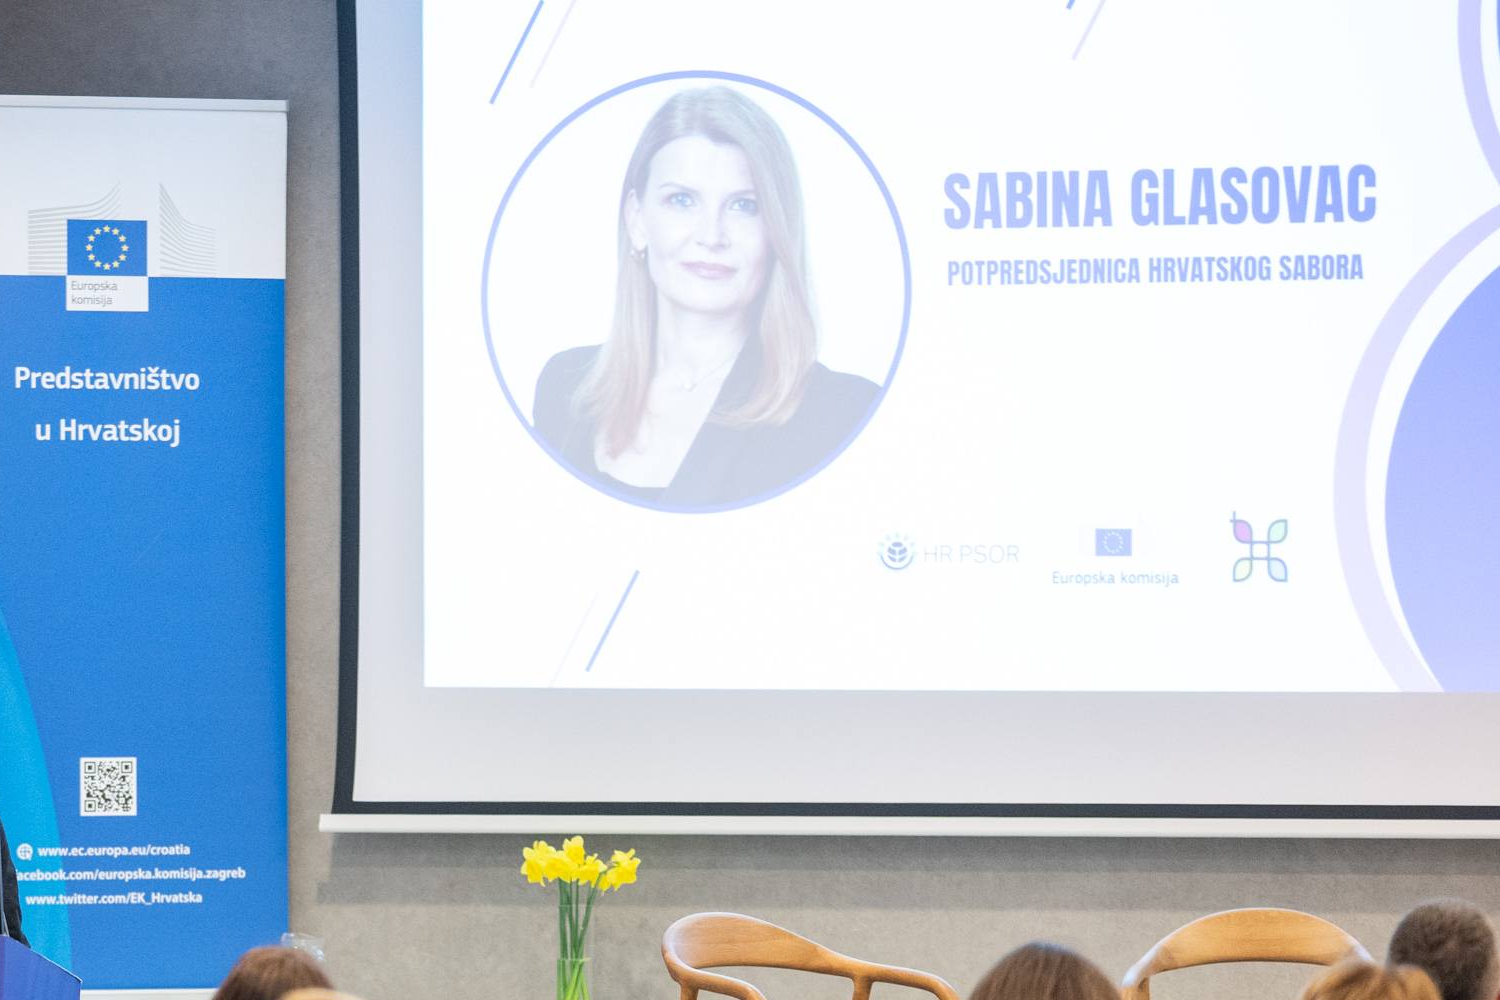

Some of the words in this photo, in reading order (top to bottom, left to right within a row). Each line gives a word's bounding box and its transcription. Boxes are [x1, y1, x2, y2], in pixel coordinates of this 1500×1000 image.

[943, 169, 1113, 230] SABINA
[1130, 163, 1377, 227] GLASOVAC
[947, 257, 1141, 286] POTPREDSJEDNICA
[1148, 255, 1272, 284] HRVATSKOG
[1279, 253, 1364, 281] SABORA
[70, 280, 118, 292] Europska
[71, 294, 113, 308] komisija
[14, 365, 200, 391] Predstavništvo
[35, 422, 51, 442] u
[59, 418, 181, 448] Hrvatskoj
[923, 544, 953, 564] HR
[960, 543, 1020, 565] PSOR
[1051, 570, 1116, 588] Europska
[1120, 570, 1180, 588] komisija
[38, 844, 191, 859] www.ec.europa.eu/croatia
[25, 891, 203, 906] www.twitter.com/EK_Hrvatska
